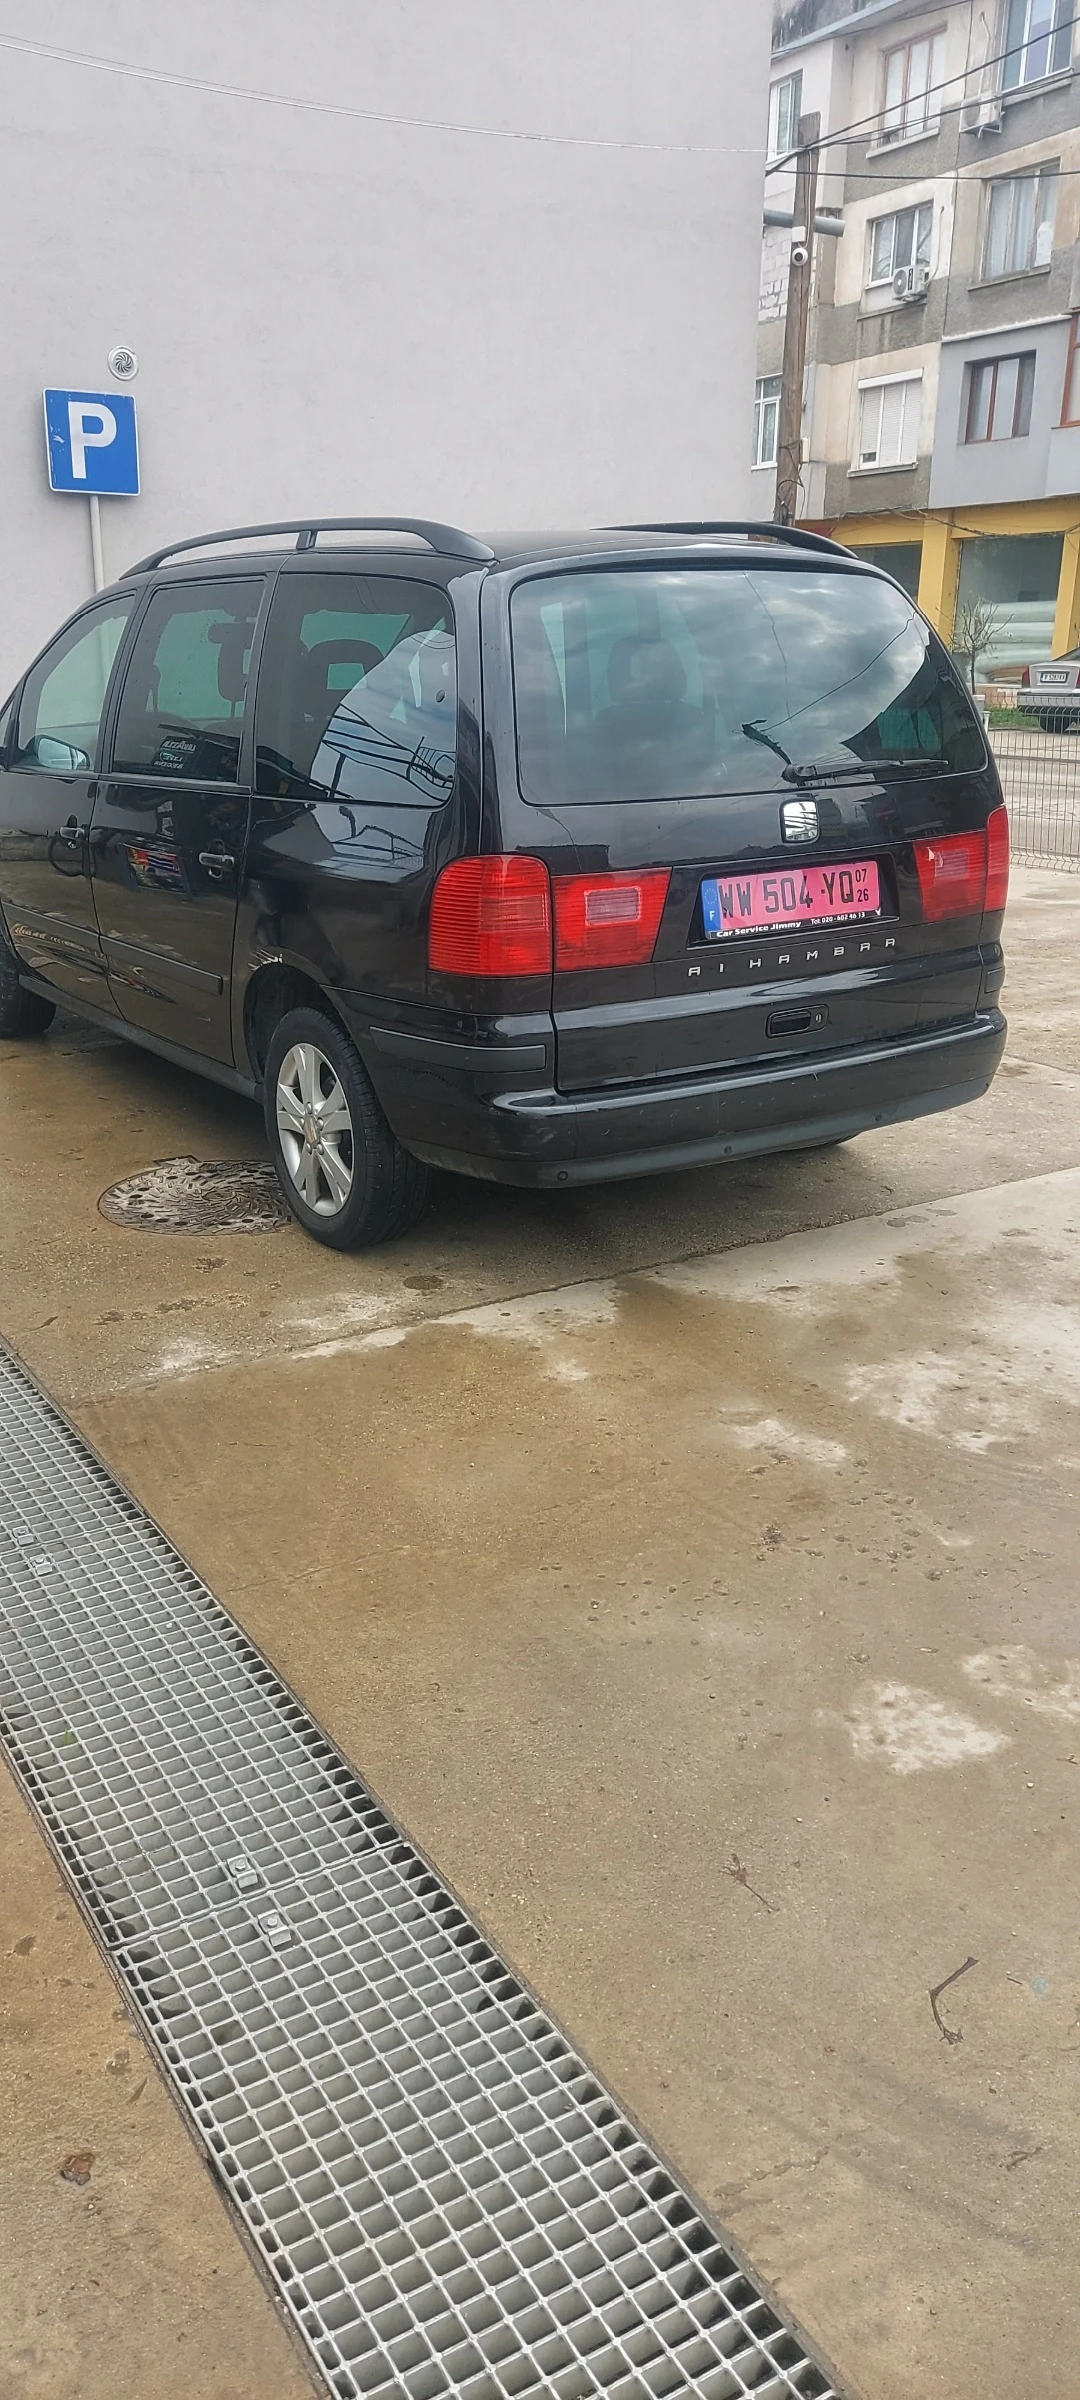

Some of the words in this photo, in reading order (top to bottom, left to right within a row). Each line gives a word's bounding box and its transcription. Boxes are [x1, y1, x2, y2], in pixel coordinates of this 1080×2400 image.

[68, 401, 117, 479] P
[855, 868, 867, 882] 07
[718, 881, 752, 919] WW
[762, 875, 813, 913] 504
[856, 888, 869, 902] 26
[709, 910, 715, 921] F
[716, 930, 735, 938] Car
[735, 925, 769, 935] Service
[770, 921, 802, 930] Jimmy
